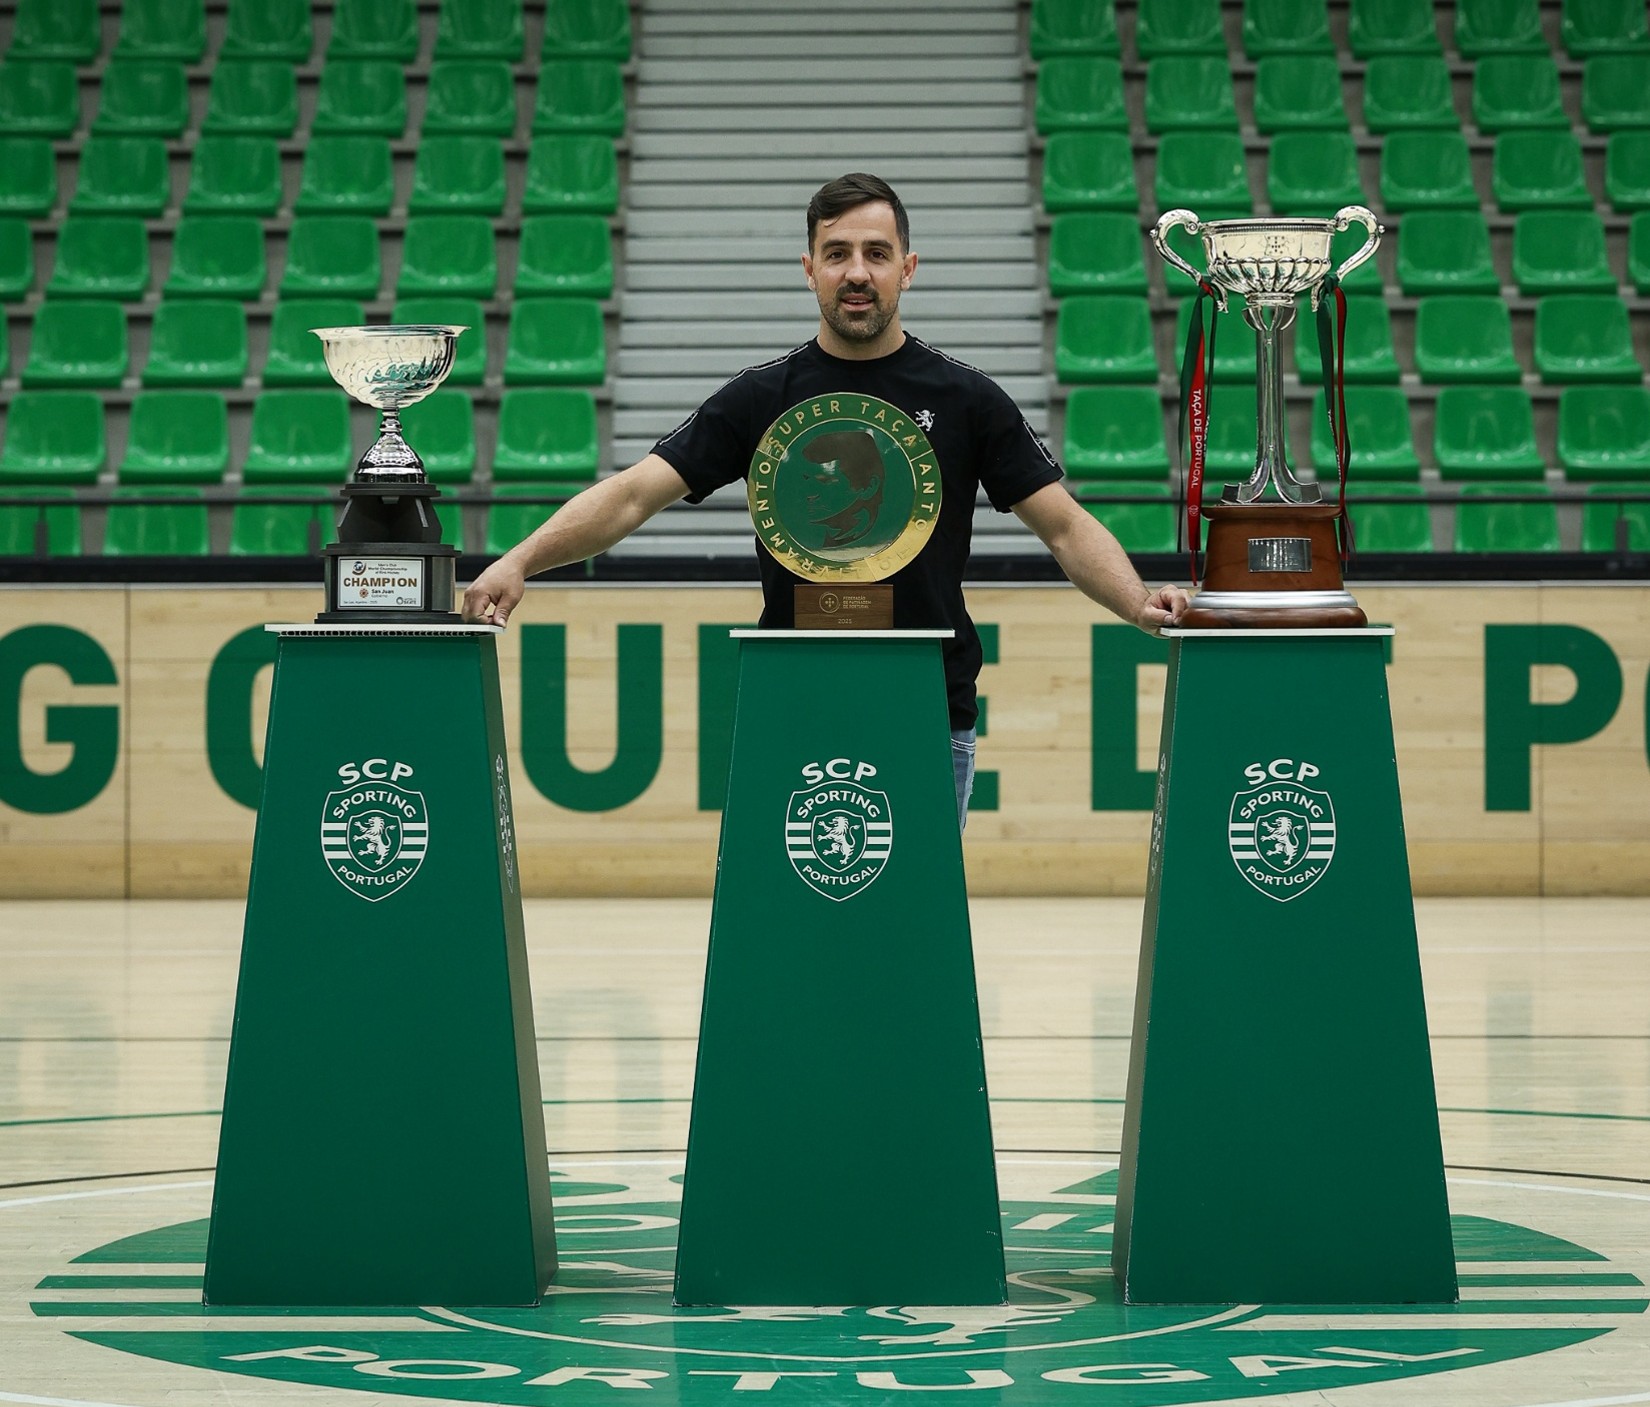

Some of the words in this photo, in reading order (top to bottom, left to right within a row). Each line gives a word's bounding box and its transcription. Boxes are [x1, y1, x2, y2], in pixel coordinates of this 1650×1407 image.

[1192, 389, 1202, 416] TAÇA
[766, 400, 840, 448] SUPER
[861, 401, 917, 448] TAÇA
[1194, 419, 1202, 432] DE
[1191, 435, 1203, 488] PORTUGAL
[343, 578, 418, 587] CHAMPION
[338, 758, 414, 784] SCP
[802, 758, 877, 784] SCP
[1244, 758, 1320, 785] SCP
[333, 791, 416, 818] SPORTING
[797, 791, 880, 818] SPORTING
[1240, 791, 1324, 819] SPORTING
[338, 865, 413, 886] PORTUGAL
[802, 865, 877, 885] PORTUGAL
[1246, 866, 1321, 886] PORTUGAL
[220, 1345, 1484, 1391] PORTUGAL
